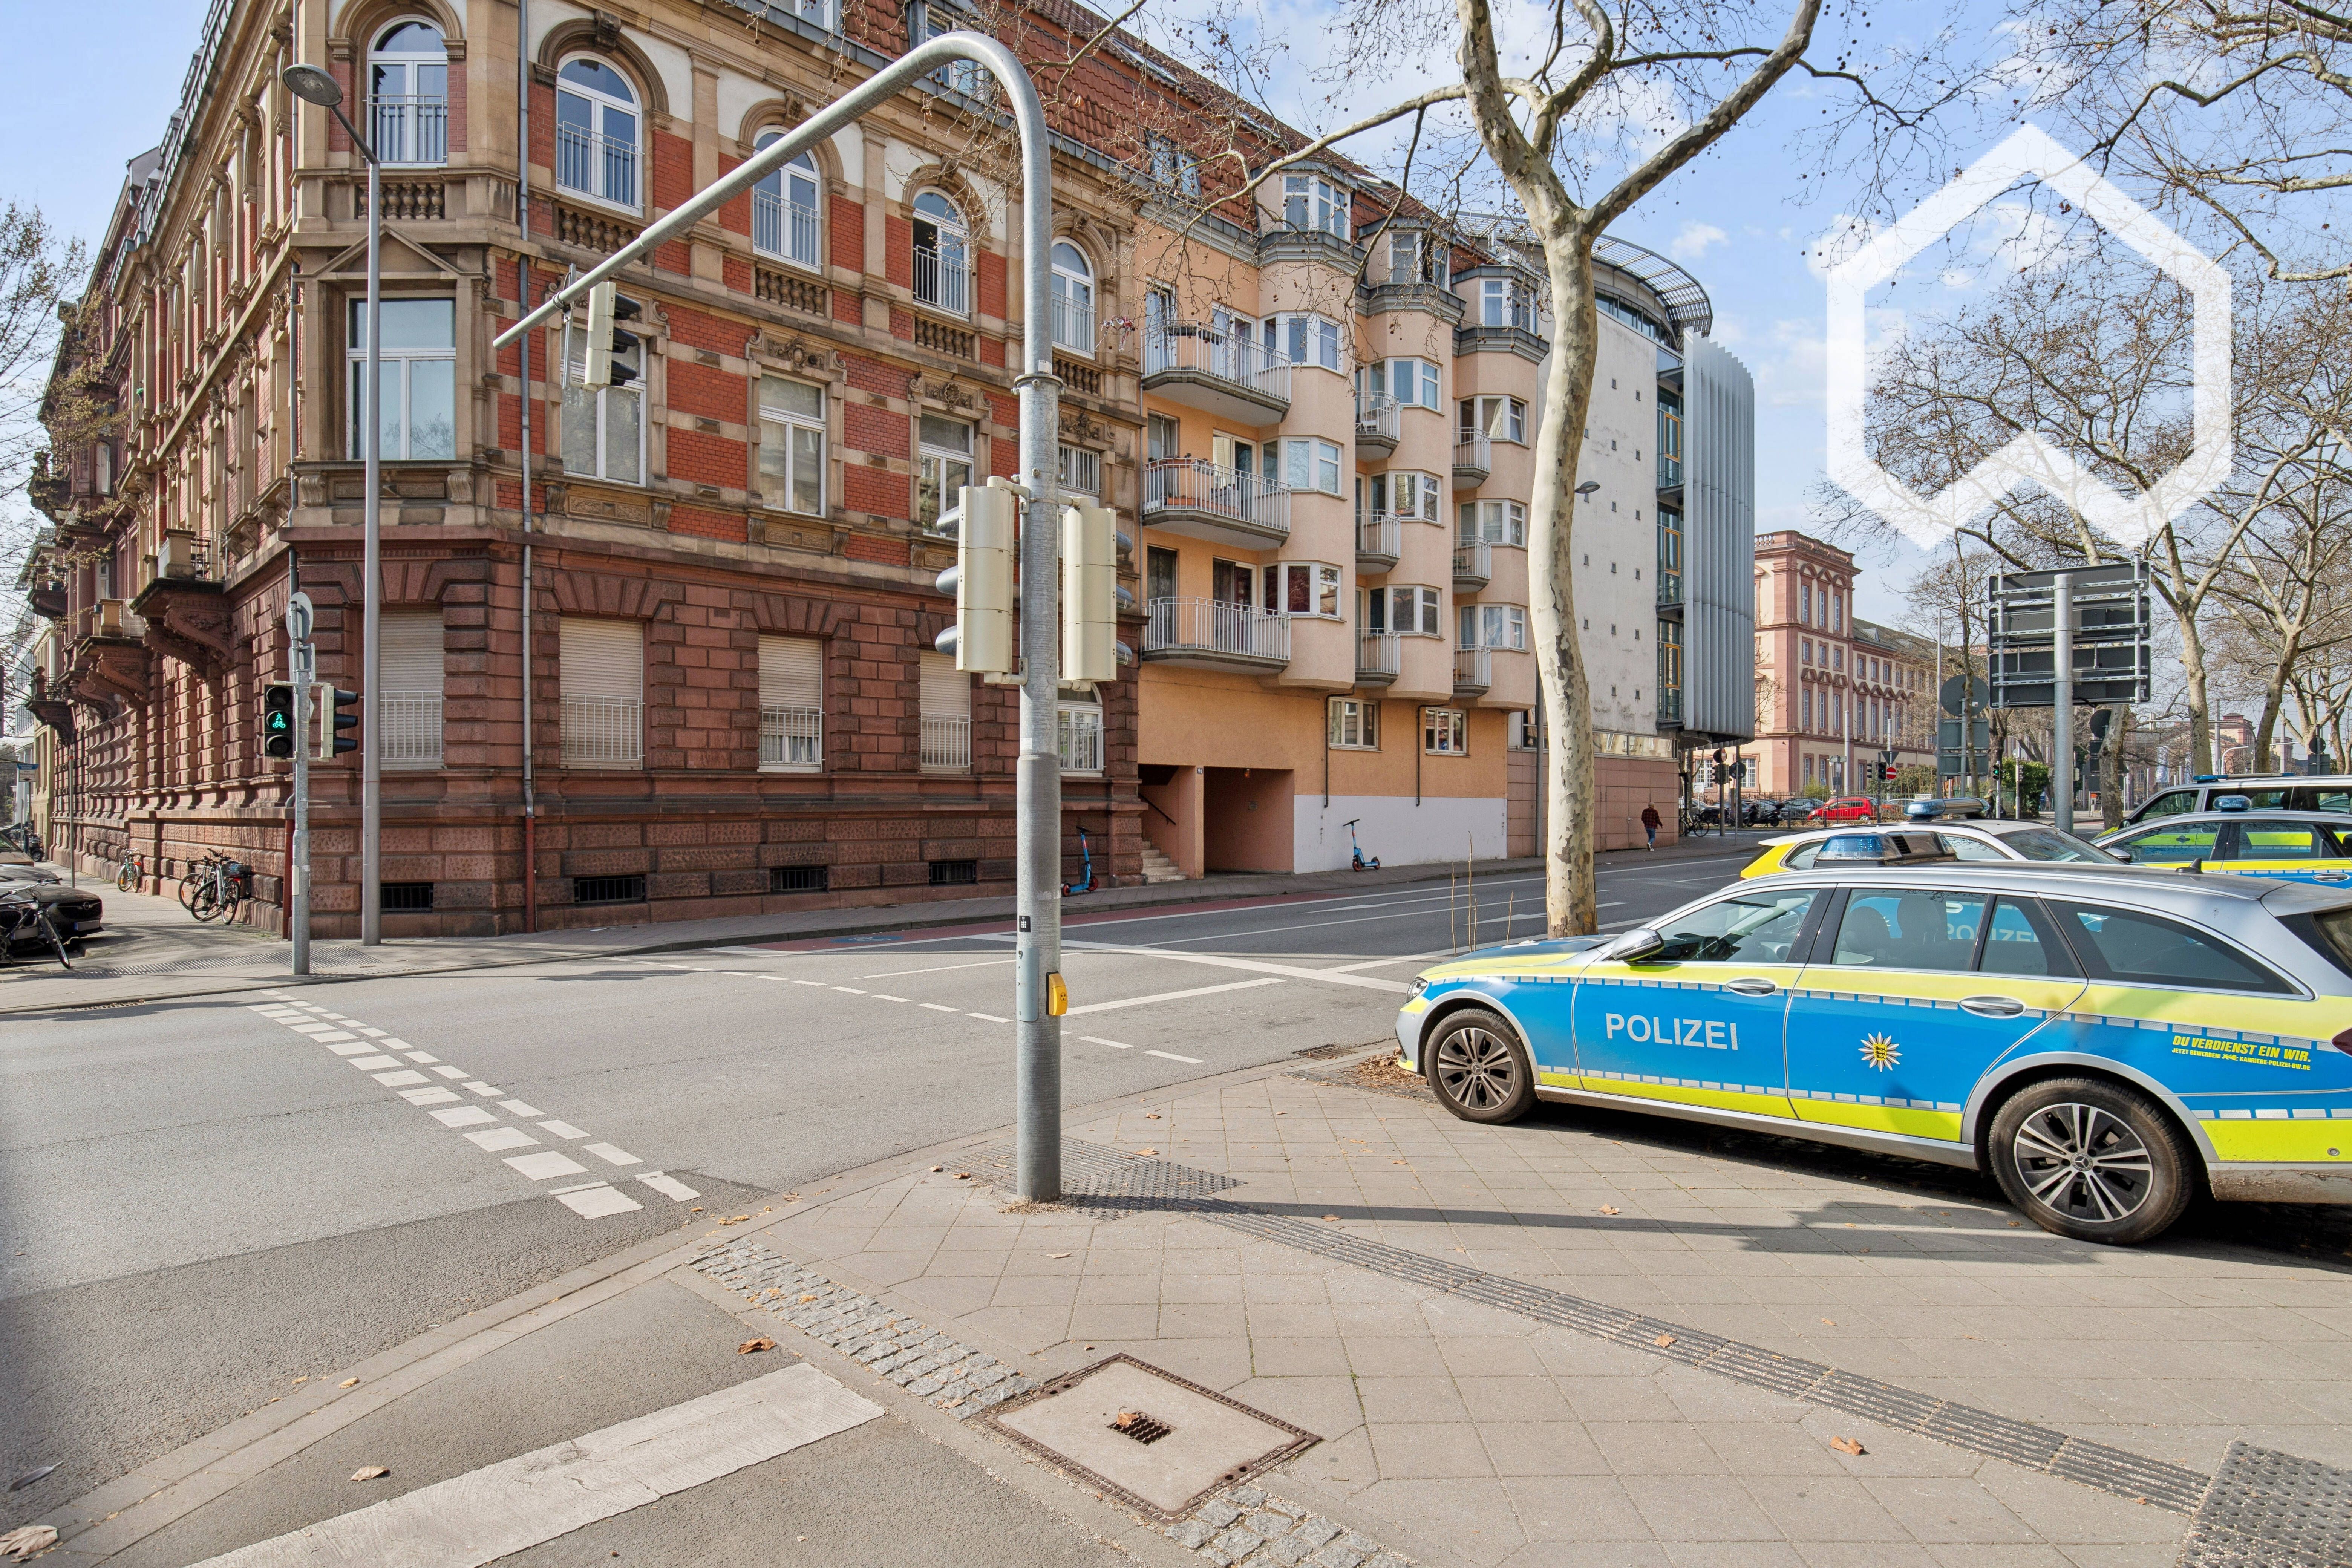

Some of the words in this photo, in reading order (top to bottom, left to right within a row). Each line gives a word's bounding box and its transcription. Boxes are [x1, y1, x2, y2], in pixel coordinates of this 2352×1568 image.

[1947, 923, 2040, 942] POIZE
[1606, 1013, 1738, 1050] POLIZEI
[2173, 1035, 2190, 1046] DU
[2191, 1037, 2257, 1055] VERDIENST
[2258, 1046, 2280, 1058] EIN
[2283, 1049, 2311, 1062] WIR.
[2190, 1050, 2221, 1059] BEWERBEN!
[2240, 1057, 2311, 1071] KARRIERE-POLIZEI-BW.DE
